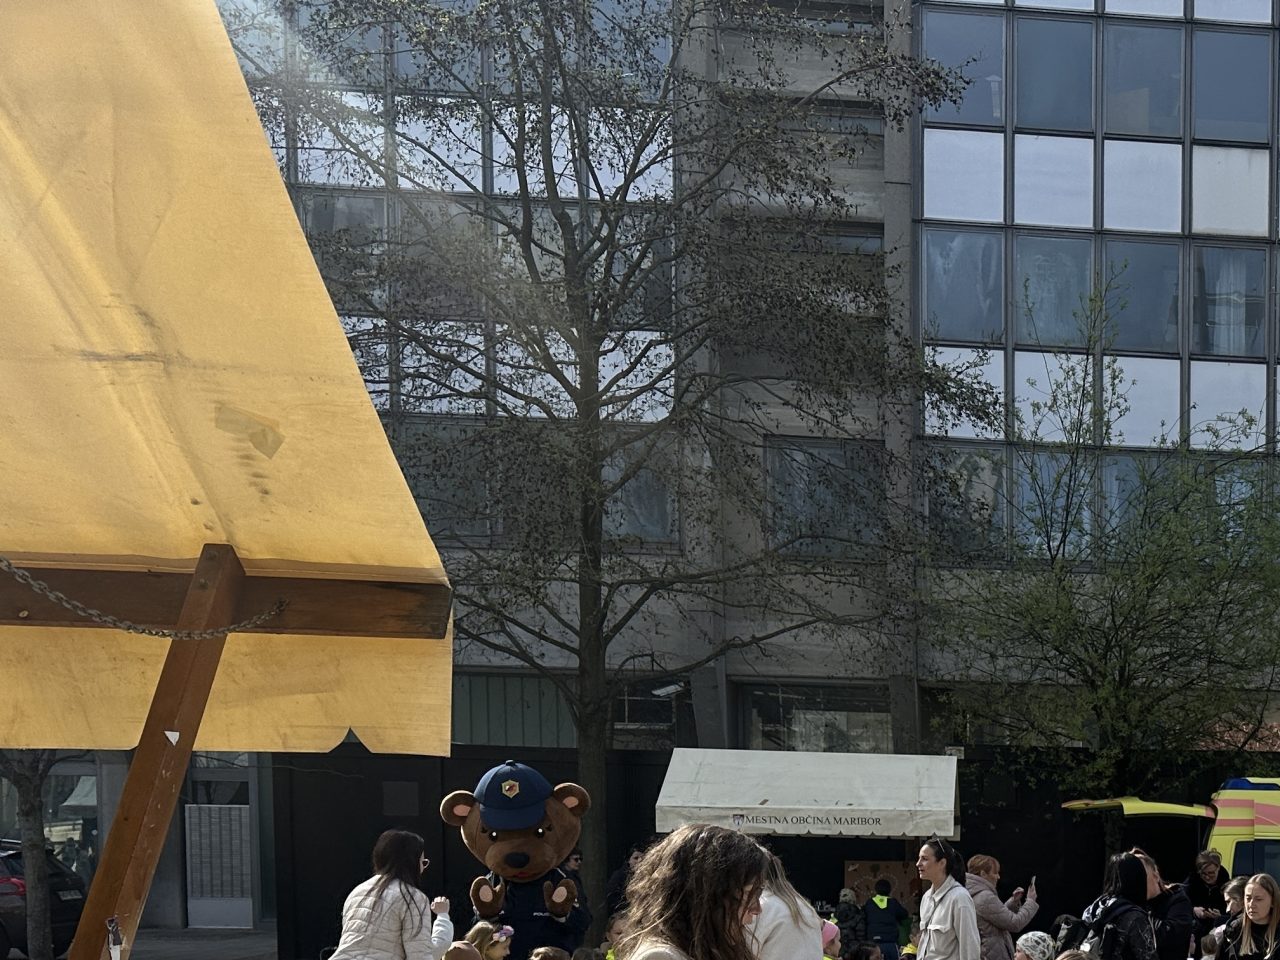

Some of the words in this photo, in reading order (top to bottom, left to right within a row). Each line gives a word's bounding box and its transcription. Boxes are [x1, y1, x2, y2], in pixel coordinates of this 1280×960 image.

[744, 815, 789, 825] MESTNA
[790, 814, 831, 826] OBČINA
[833, 816, 882, 826] MARIBOR
